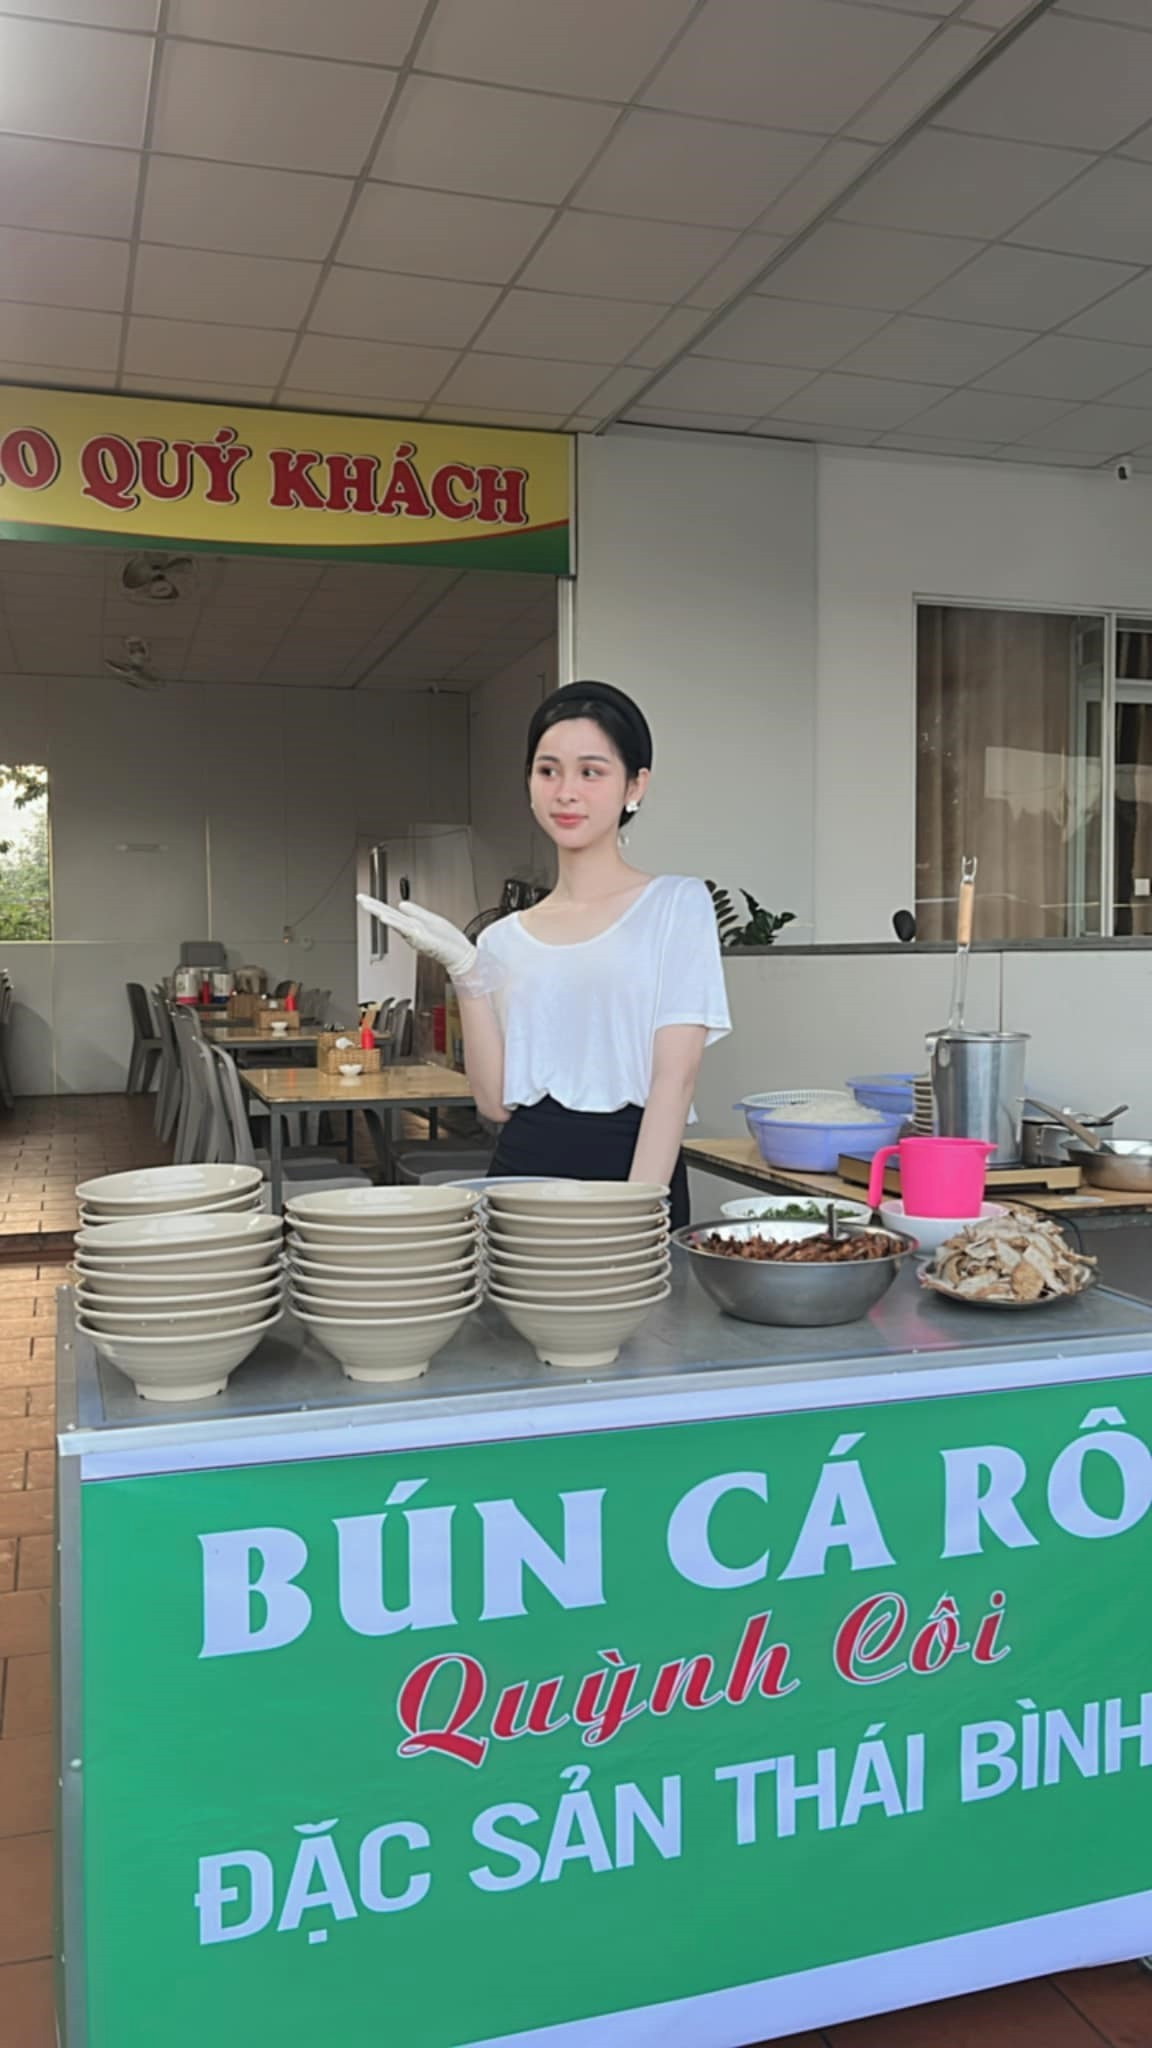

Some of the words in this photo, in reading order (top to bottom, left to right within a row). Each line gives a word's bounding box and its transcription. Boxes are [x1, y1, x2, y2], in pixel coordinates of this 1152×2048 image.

[80, 427, 252, 513] QUÝ
[268, 442, 529, 525] KHÁCH
[197, 1478, 607, 1659] BÚN
[667, 1432, 897, 1589] CÁ
[940, 1406, 1152, 1559] RÔ
[396, 1610, 800, 1768] Quỳnh
[833, 1590, 1010, 1685] Côi
[194, 1818, 432, 1946] ĐẶC
[469, 1765, 681, 1892] SẢN
[715, 1722, 926, 1846] THÁI
[960, 1692, 1152, 1803] BÌNH
